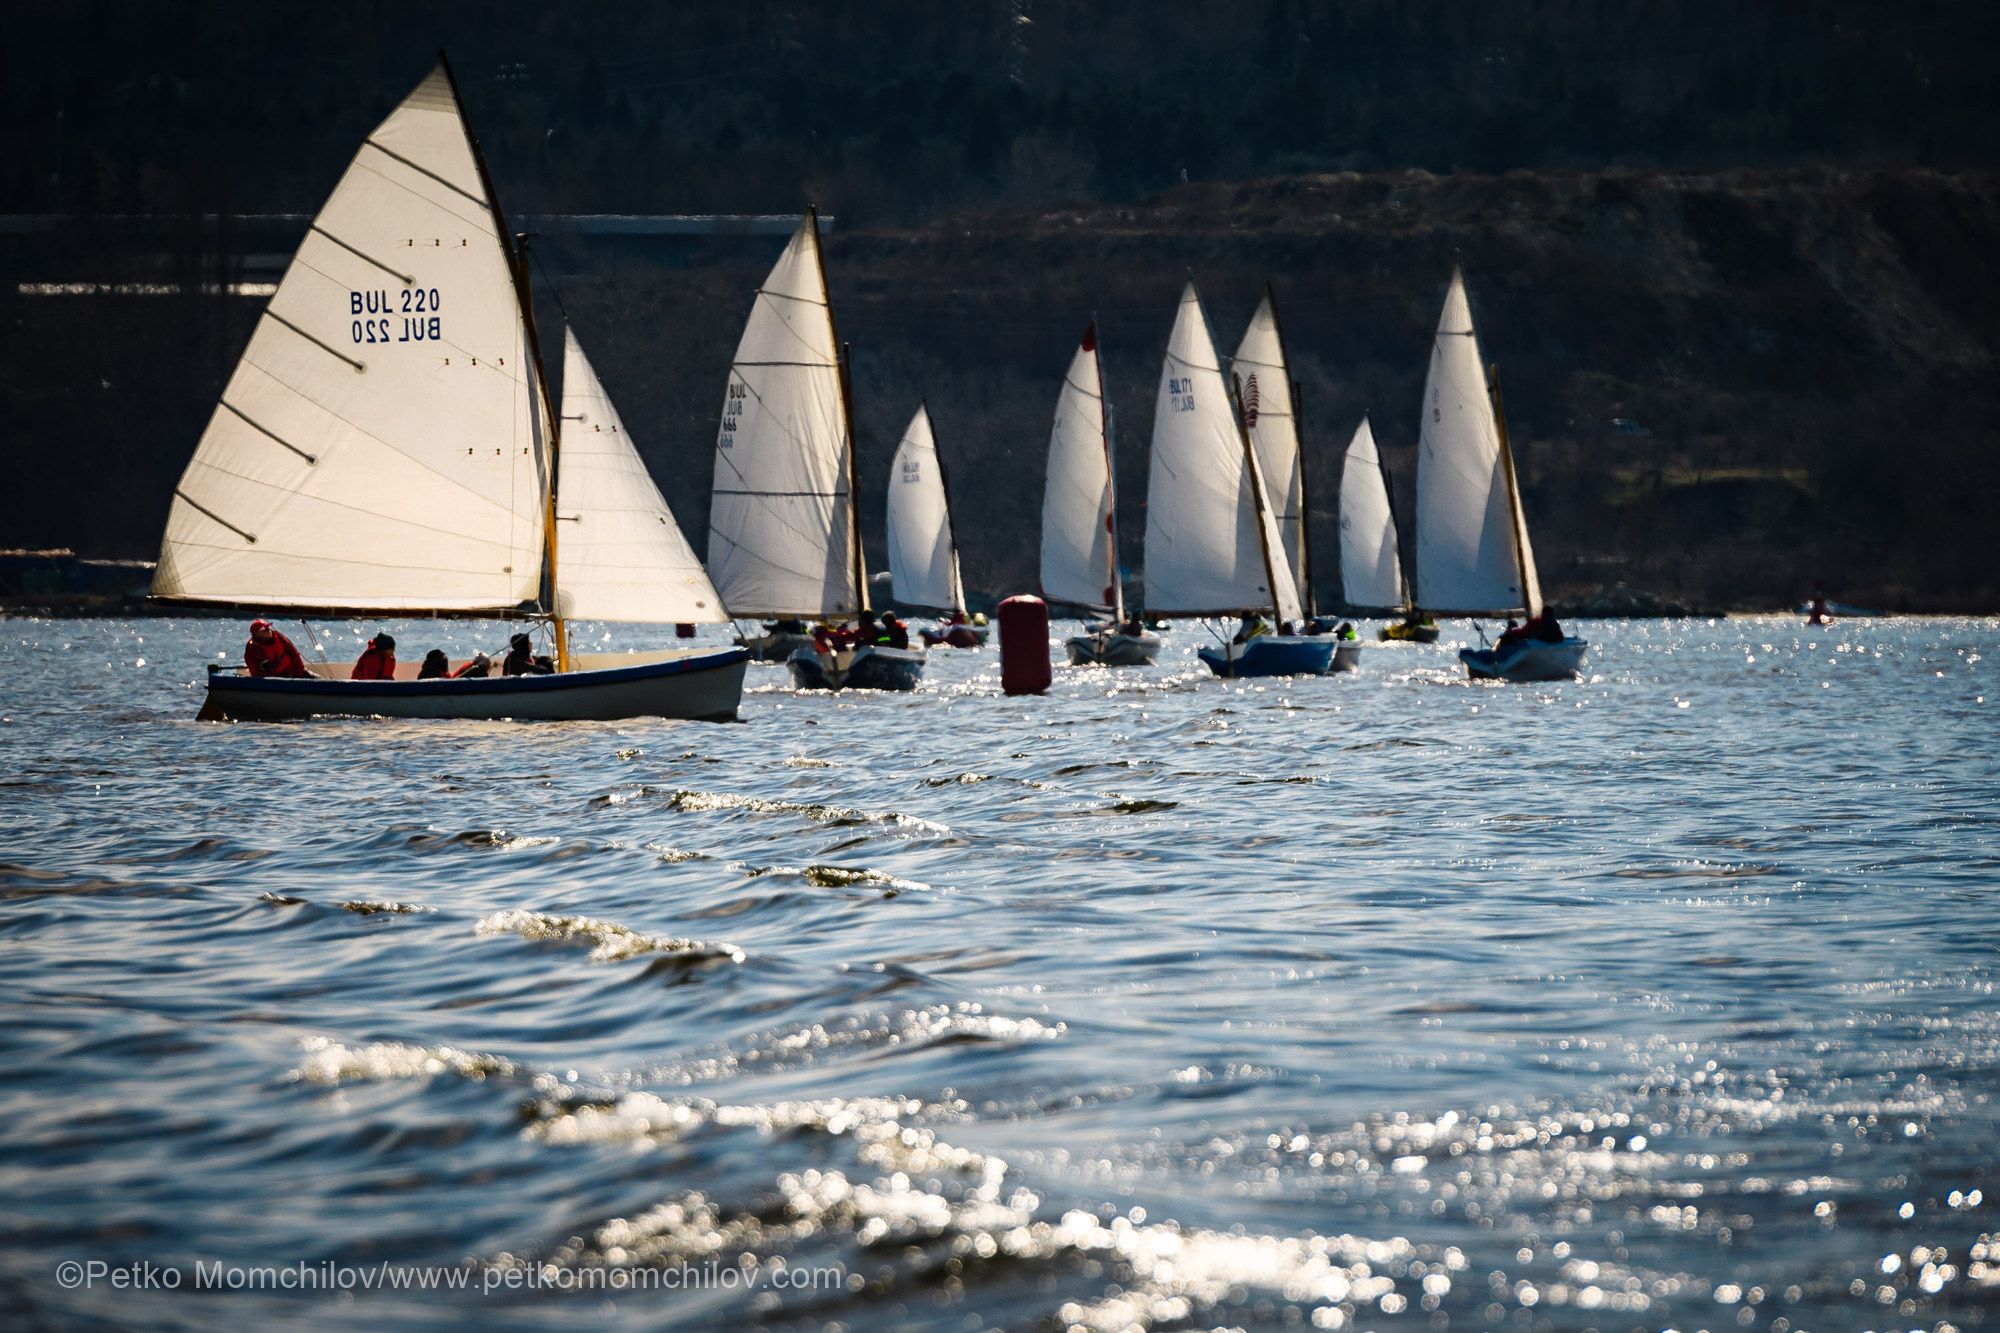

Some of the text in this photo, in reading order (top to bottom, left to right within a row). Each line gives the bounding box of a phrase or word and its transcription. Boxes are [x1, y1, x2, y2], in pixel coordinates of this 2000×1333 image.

[351, 288, 440, 315] BUL 220
[730, 384, 747, 399] BUL
